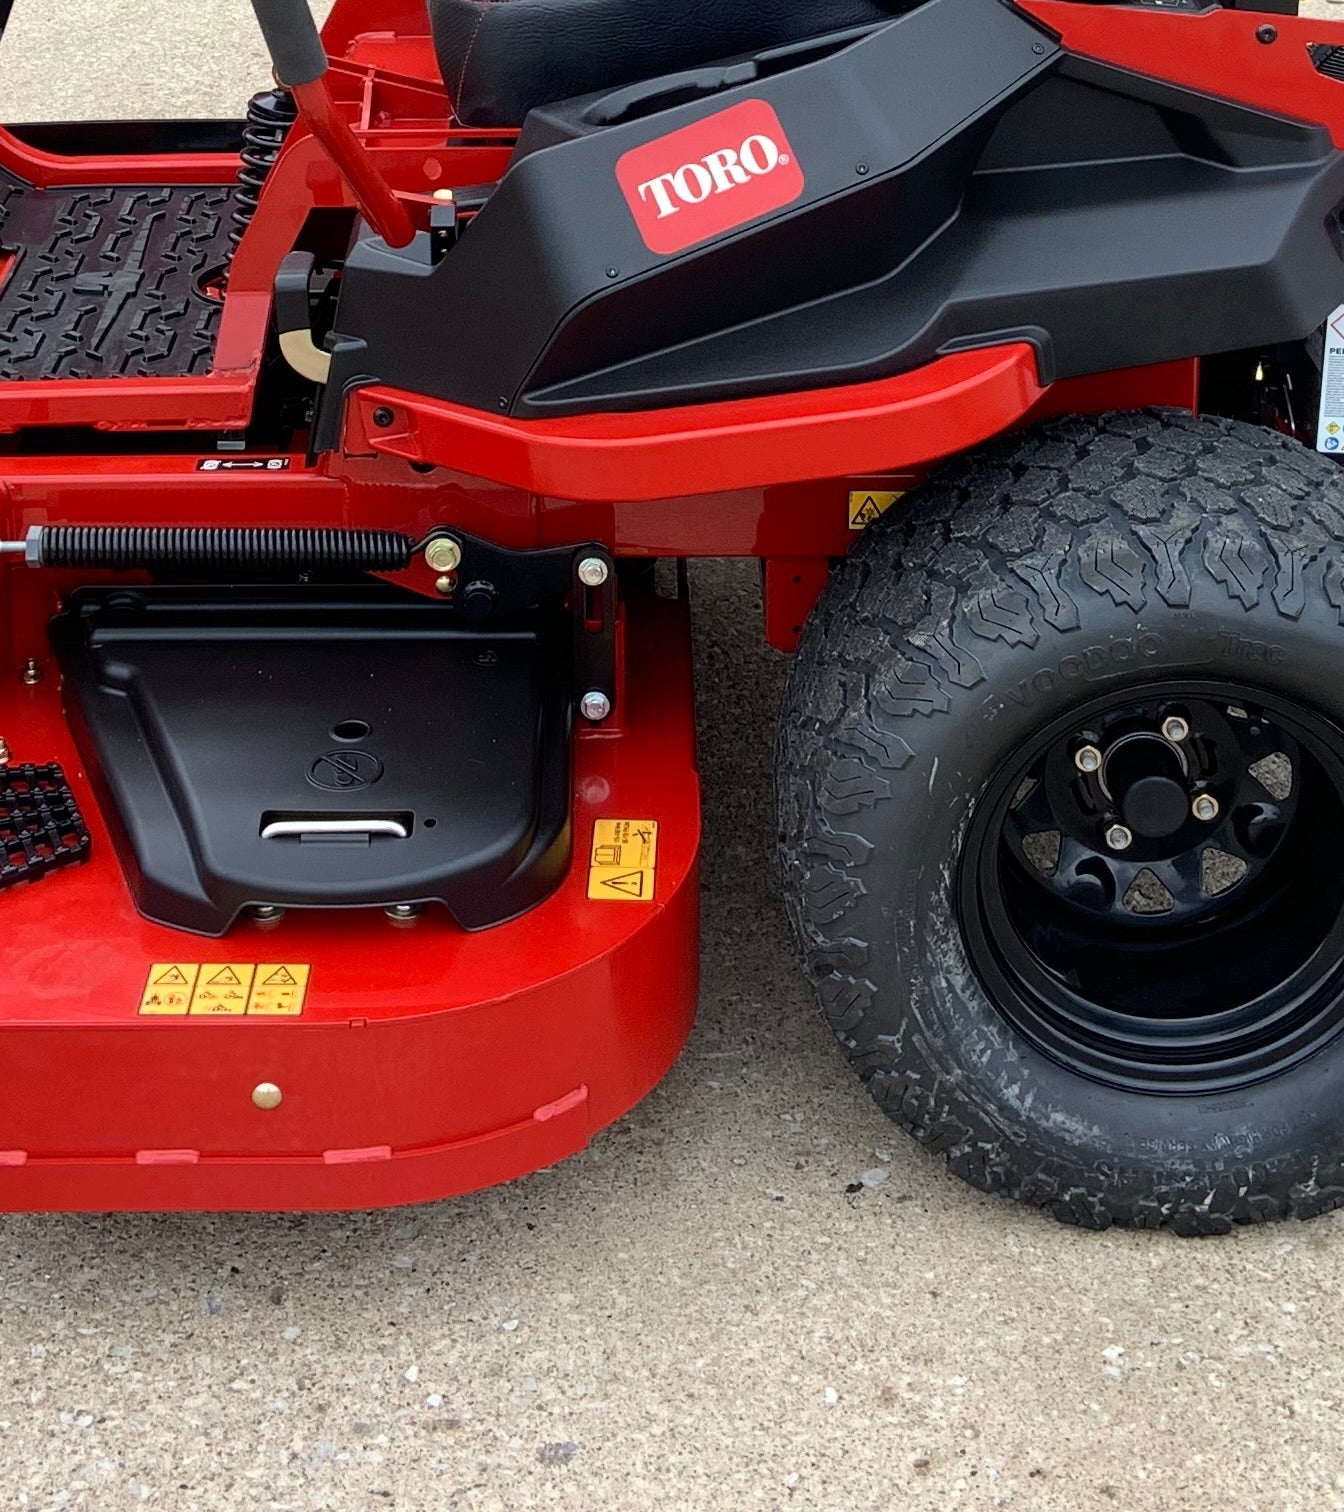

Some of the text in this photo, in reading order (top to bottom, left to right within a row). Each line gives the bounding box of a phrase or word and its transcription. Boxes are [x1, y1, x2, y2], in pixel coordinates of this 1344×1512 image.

[638, 135, 780, 219] TORO
[1006, 630, 1285, 706] VOODOO Trac
